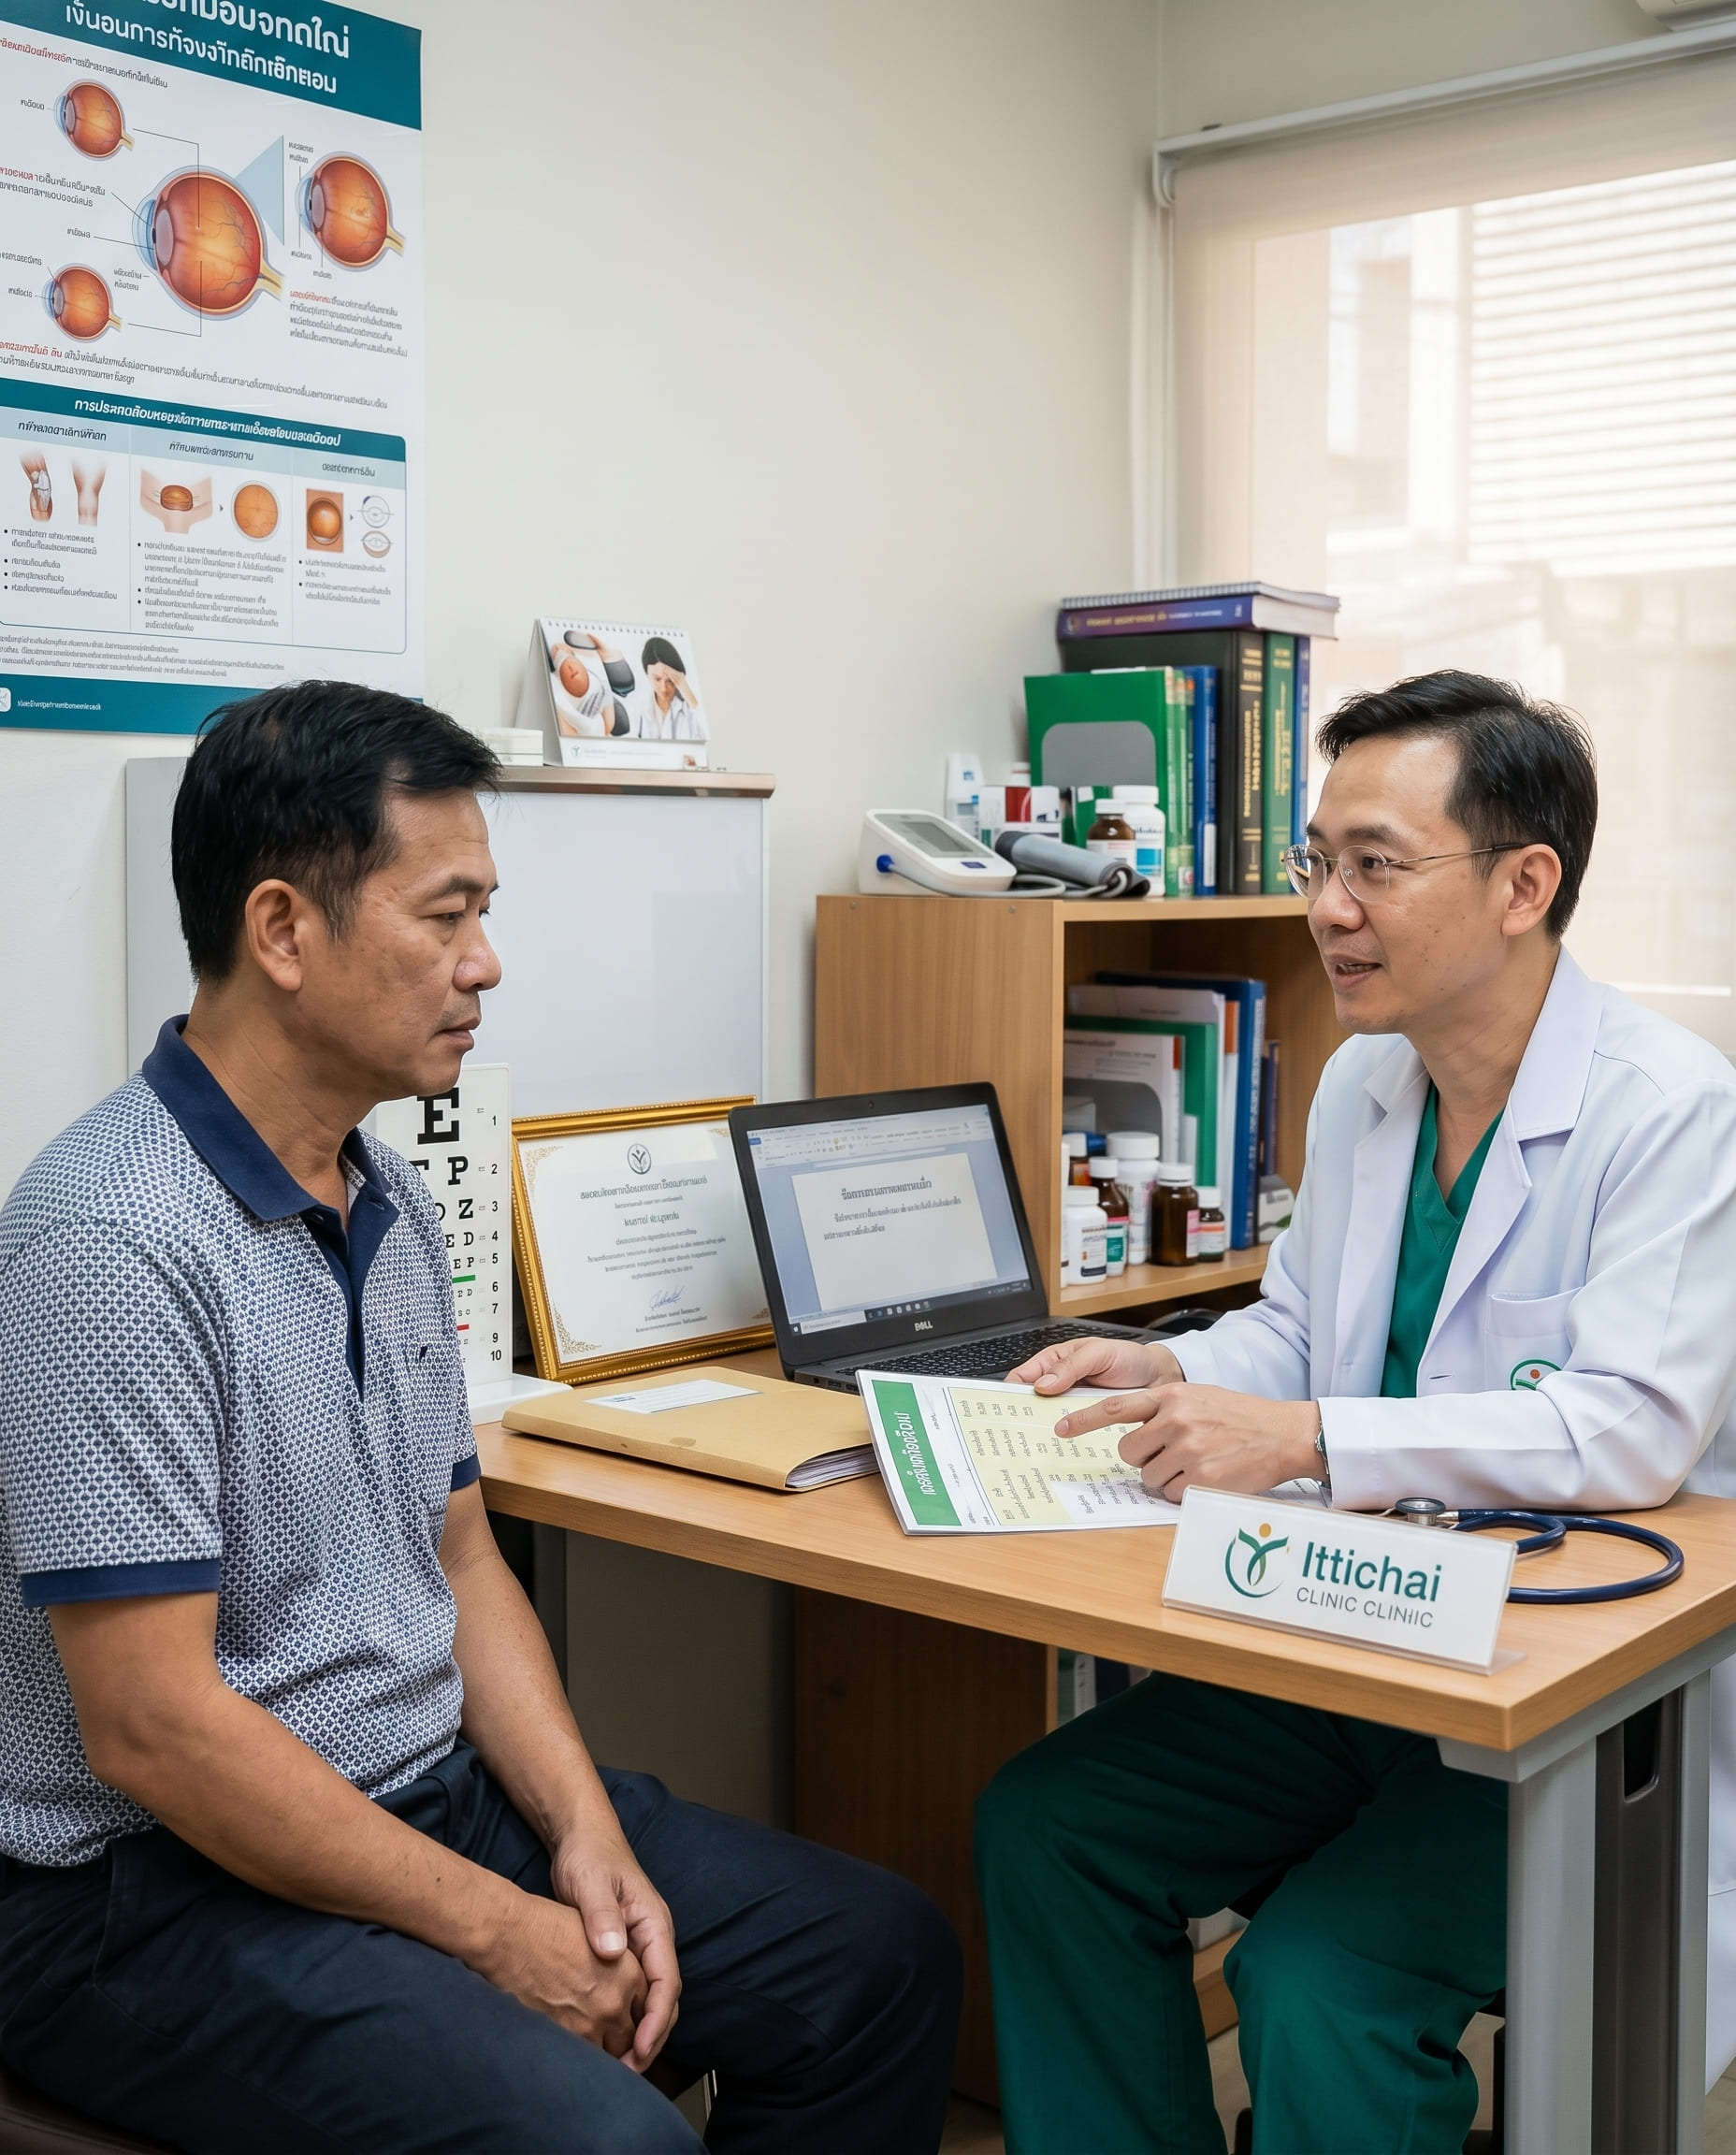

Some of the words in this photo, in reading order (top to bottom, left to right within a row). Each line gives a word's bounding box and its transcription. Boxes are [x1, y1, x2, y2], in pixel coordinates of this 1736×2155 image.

[416, 1087, 460, 1145] E
[492, 1115, 497, 1126] 1
[447, 1155, 469, 1186] P
[491, 1163, 499, 1175] 2
[458, 1198, 474, 1220] Z
[492, 1200, 499, 1212] 3
[444, 1233, 456, 1249] E
[463, 1231, 474, 1247] D
[491, 1230, 499, 1242] 4
[453, 1258, 461, 1270] E
[467, 1256, 475, 1268] P
[492, 1252, 499, 1265] 5
[492, 1280, 499, 1293] 6
[492, 1303, 499, 1314] 7
[492, 1332, 499, 1343] 9
[490, 1349, 502, 1362] 10
[1302, 1541, 1442, 1602] Ittichai
[1296, 1586, 1358, 1613] CLINIC
